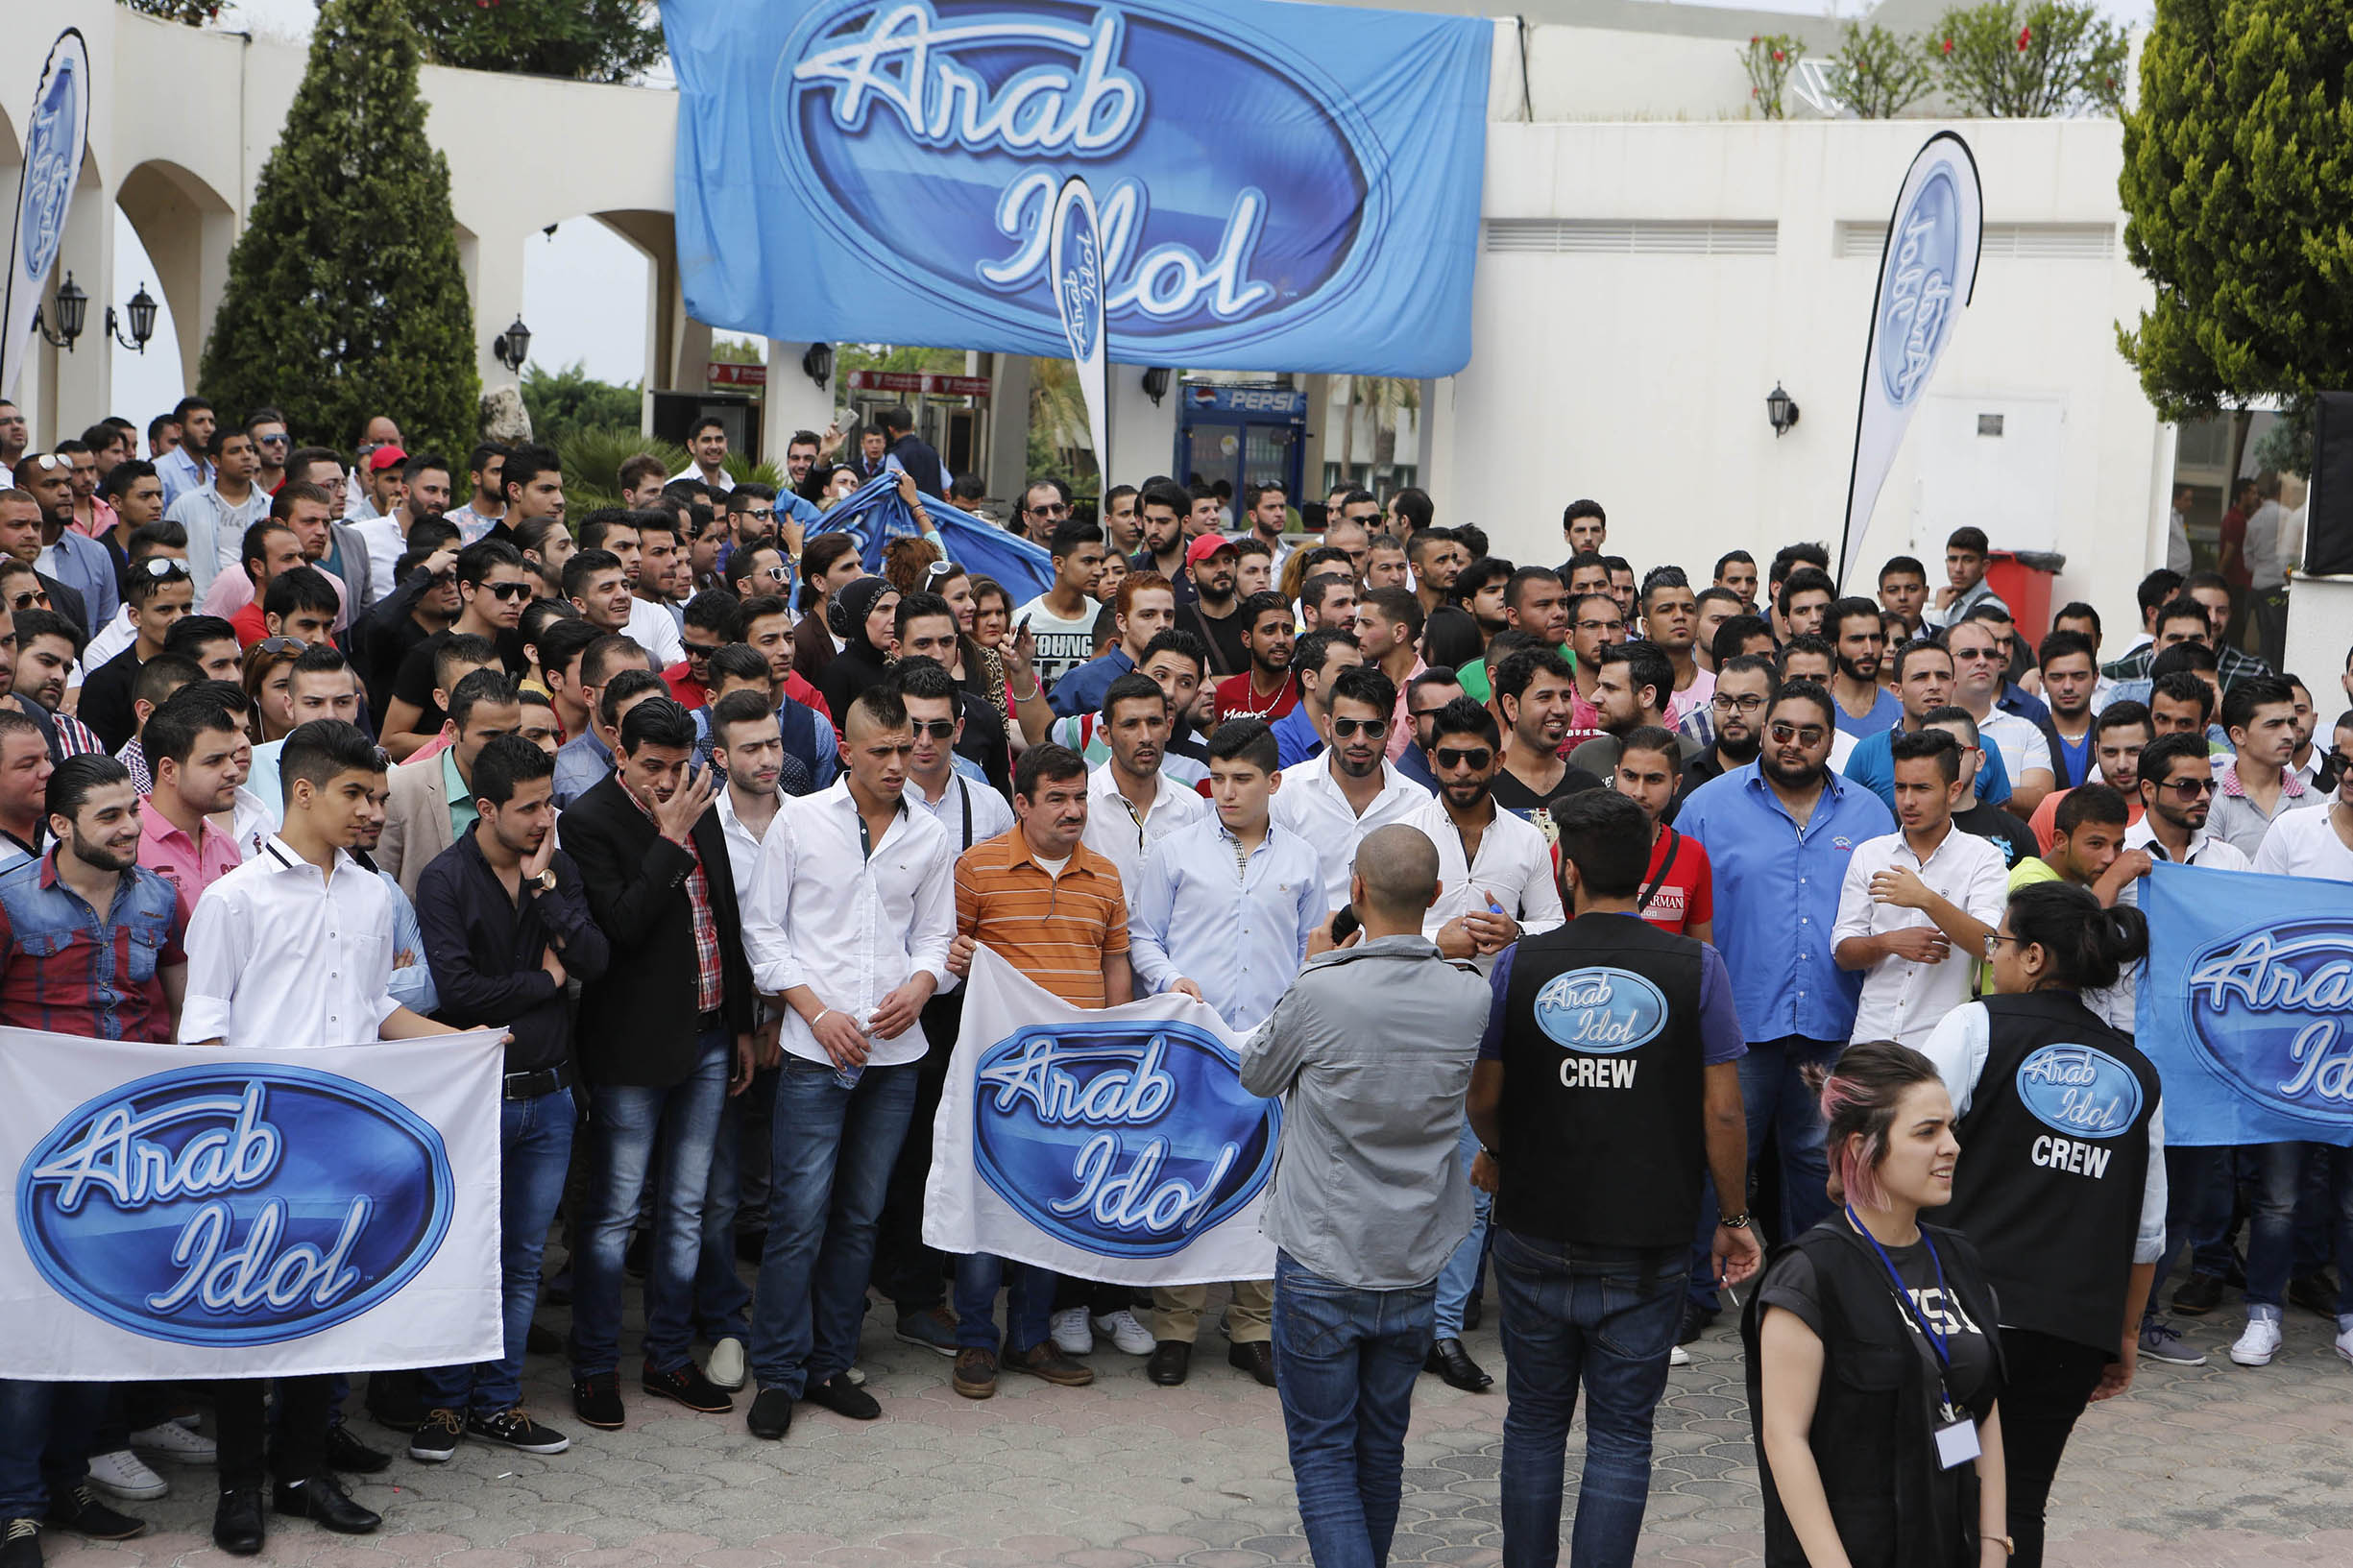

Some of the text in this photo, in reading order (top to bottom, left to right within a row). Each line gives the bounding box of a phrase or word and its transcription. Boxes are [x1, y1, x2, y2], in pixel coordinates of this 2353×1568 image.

[793, 4, 1136, 148] Arab
[1077, 229, 1098, 307] Idol
[1062, 269, 1087, 357] Arab
[1230, 391, 1296, 412] PEPSI
[1032, 635, 1093, 657] OUNG
[1539, 973, 1613, 1009] Arab
[2190, 936, 2353, 1009] Ara
[1572, 1009, 1637, 1042] Idol
[2279, 1019, 2353, 1101] Id
[980, 1038, 1169, 1120] Arab
[1560, 1058, 1637, 1089] CREW
[2024, 1051, 2097, 1084] Arab
[2053, 1088, 2120, 1128] Idol
[33, 1087, 274, 1204] Arab
[2031, 1135, 2112, 1179] CREW
[1051, 1134, 1234, 1231] Idol
[149, 1198, 356, 1309] Idol
